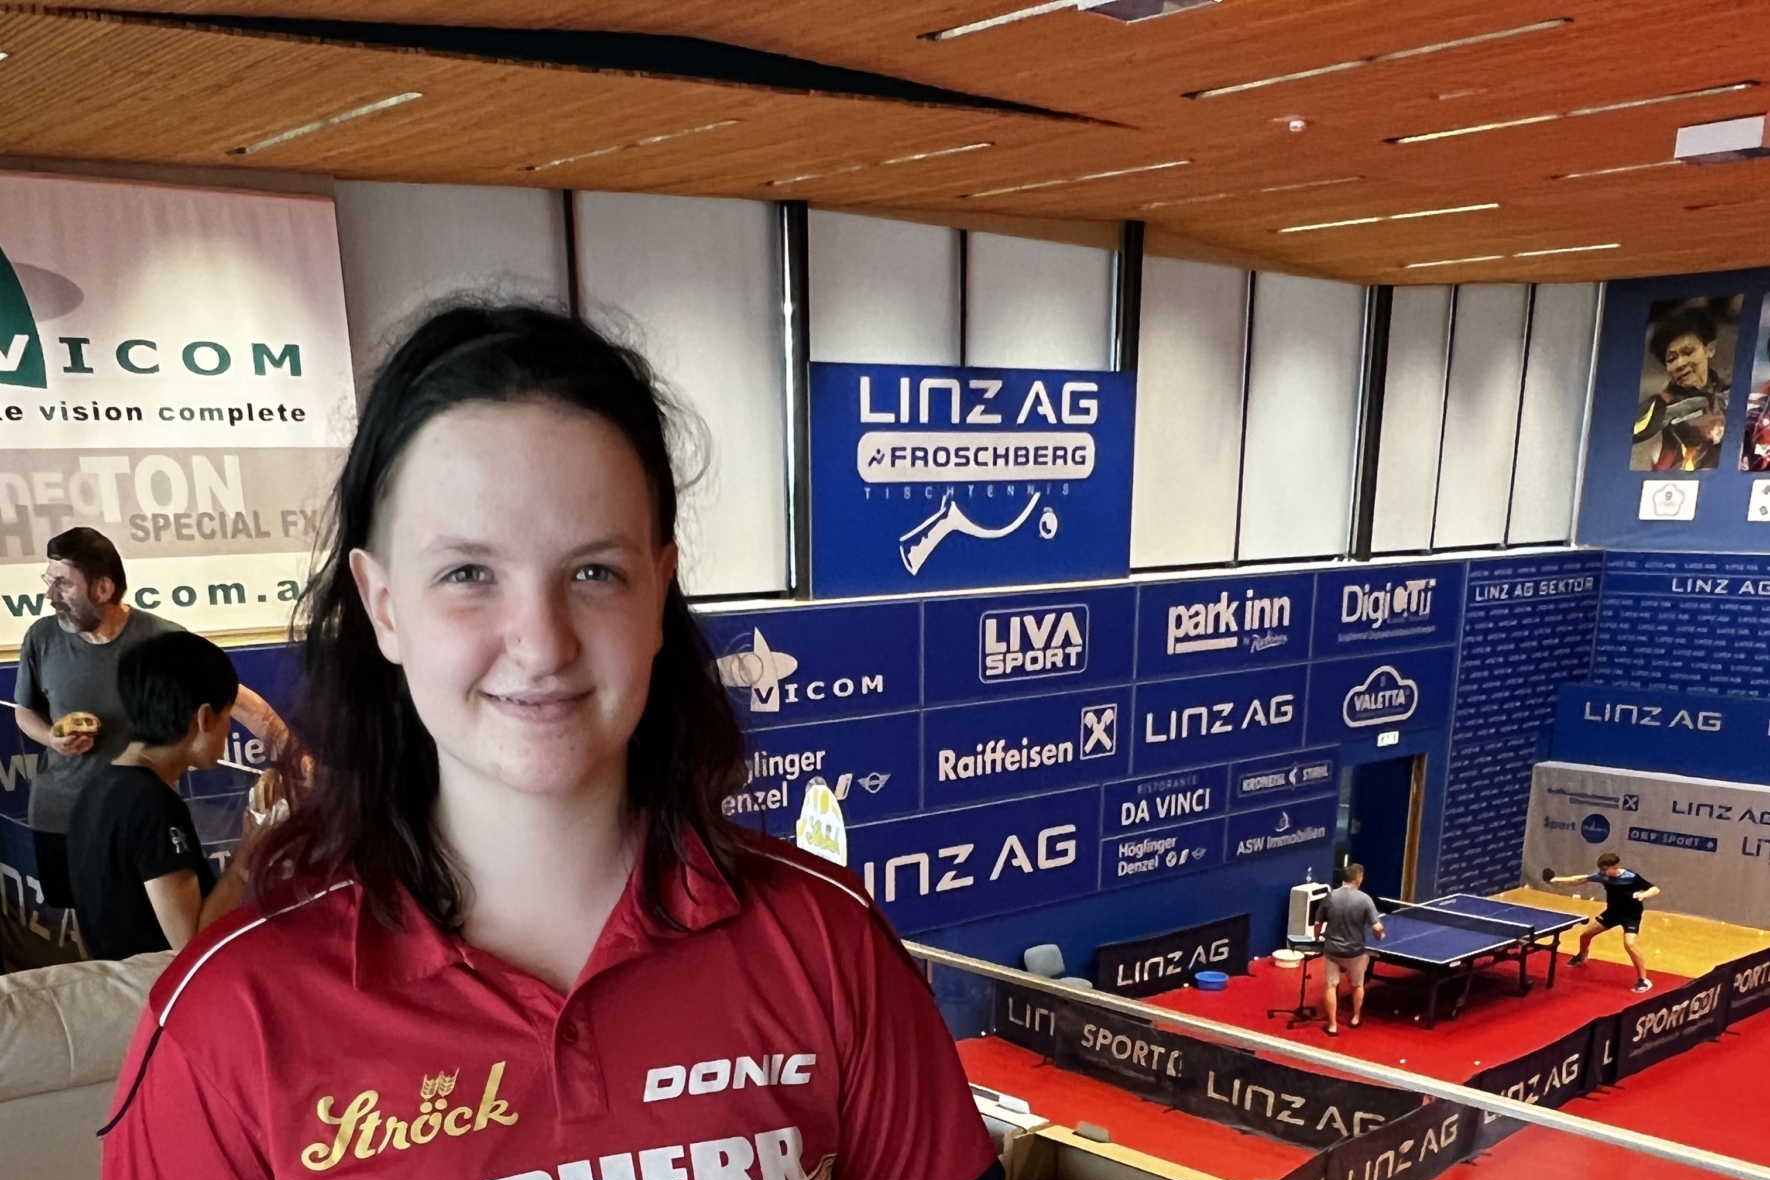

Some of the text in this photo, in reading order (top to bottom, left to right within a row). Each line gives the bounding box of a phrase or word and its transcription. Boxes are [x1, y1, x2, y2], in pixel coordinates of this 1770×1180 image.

[39, 400, 143, 423] vision
[158, 403, 307, 427] complete
[859, 375, 1099, 425] LINZ AG
[890, 445, 1087, 468] FROSCHBERG
[79, 455, 246, 524] TON
[129, 510, 272, 543] SPECIAL
[1475, 577, 1594, 602] LINZ AG SEKTOR
[1671, 578, 1729, 594] LINZ
[985, 611, 1083, 655] LIVA
[1167, 591, 1238, 655] park
[1243, 589, 1291, 631] inn
[985, 646, 1083, 677] SPORT
[753, 674, 884, 705] VICOM
[1354, 689, 1405, 712] VALETTA
[1145, 693, 1295, 744] LINZ AG
[1584, 702, 1723, 732] LINZ AG
[938, 737, 1074, 782] Raiffeisen
[1120, 787, 1211, 827] DA VINCI
[1672, 800, 1734, 821] LINZ
[989, 823, 1077, 882] AG
[1236, 826, 1326, 857] ASW Immobilien
[1117, 856, 1159, 878] Denzel
[1116, 938, 1230, 987] LINZ AG
[642, 1053, 817, 1103] DONIC
[1543, 1053, 1580, 1096] AG
[301, 1061, 519, 1172] Ströck
[1207, 1070, 1386, 1138] LINZ AG
[1419, 1113, 1459, 1163] AG
